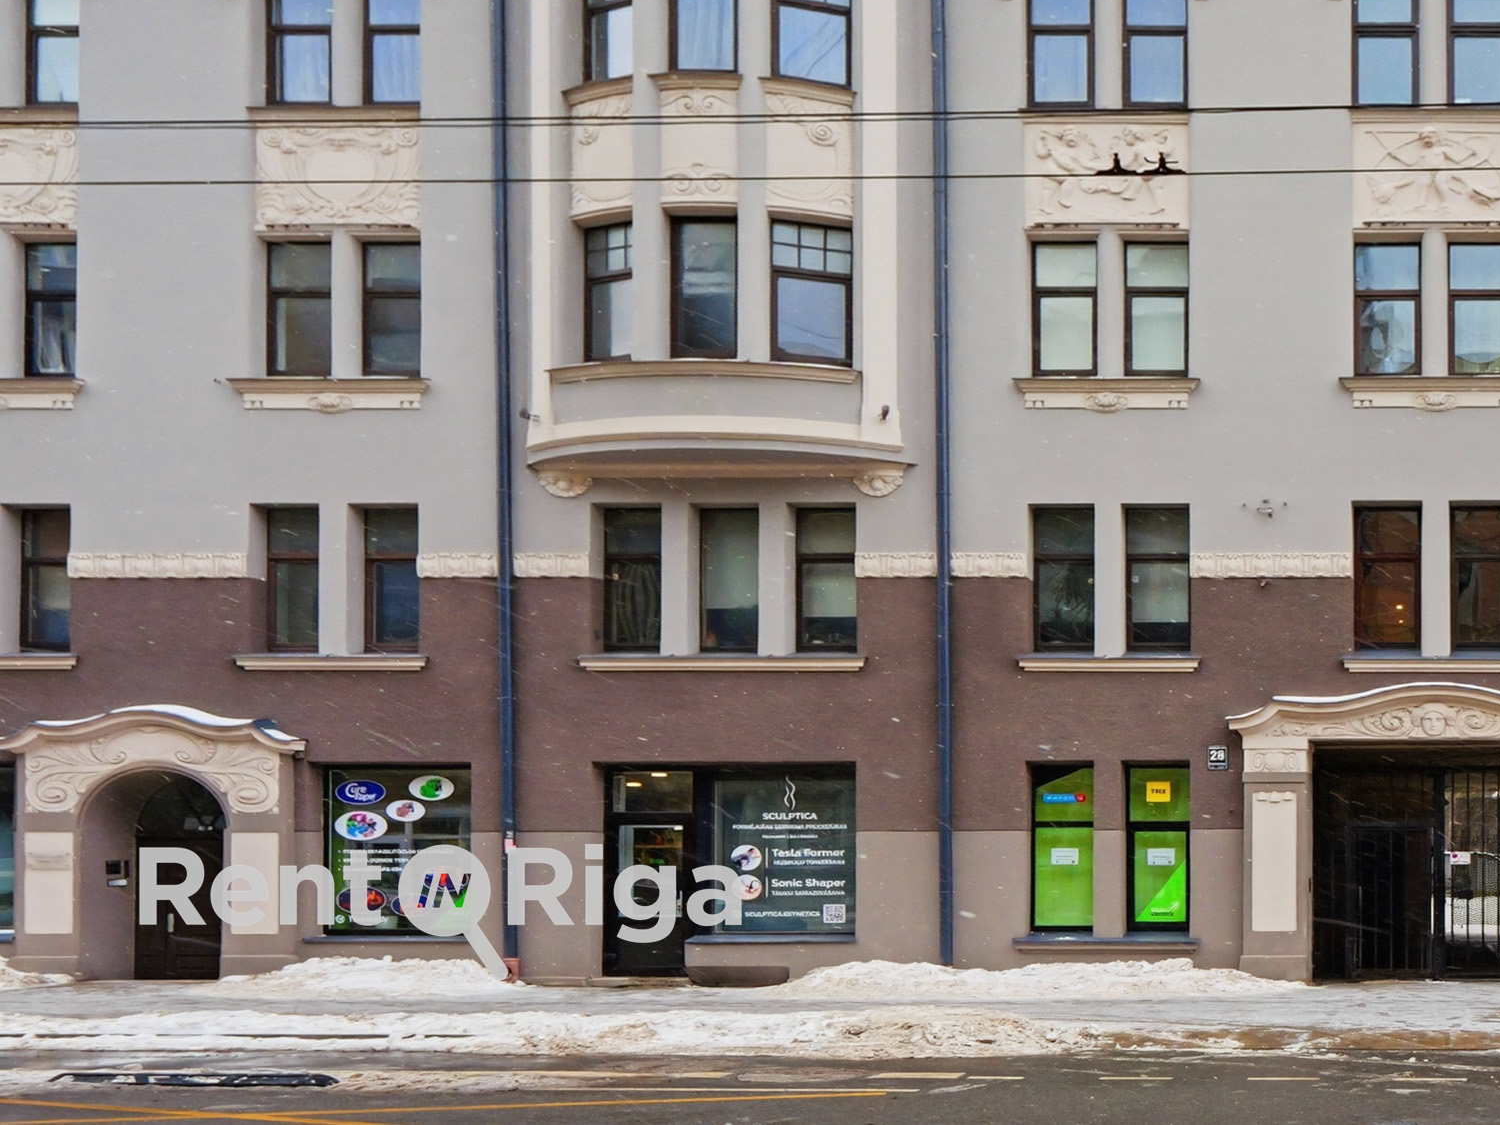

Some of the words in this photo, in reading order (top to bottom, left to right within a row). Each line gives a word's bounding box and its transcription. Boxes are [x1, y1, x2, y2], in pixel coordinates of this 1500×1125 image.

[1210, 750, 1225, 761] 28
[762, 812, 818, 820] SCULPTICA
[771, 848, 802, 857] Tesla
[804, 848, 845, 857] Former
[771, 879, 803, 887] Sonic
[805, 878, 846, 888] Shaper
